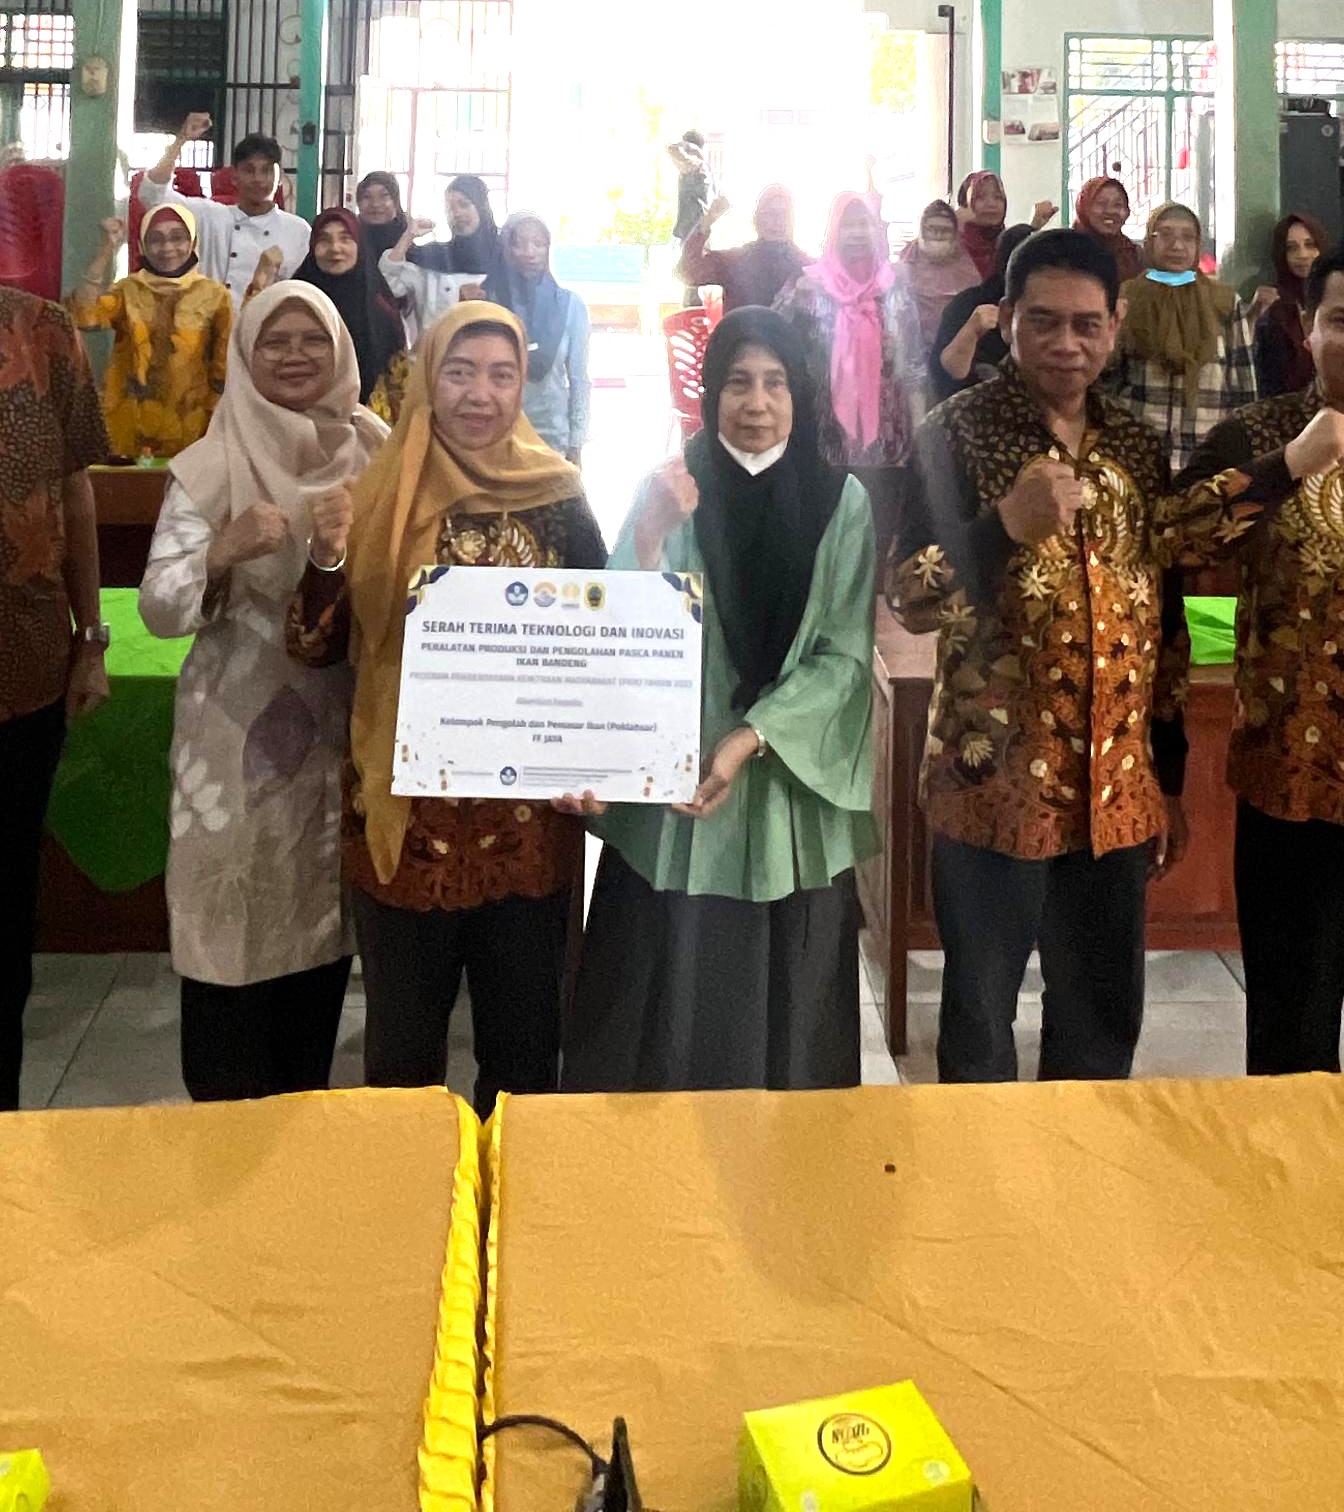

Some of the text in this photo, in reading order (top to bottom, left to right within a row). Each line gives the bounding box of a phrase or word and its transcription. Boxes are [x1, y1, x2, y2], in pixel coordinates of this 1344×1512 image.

[422, 620, 685, 640] SERAH TERIMA TEKNOLOGI DAN INOVASI
[421, 642, 684, 659] PERALATAN PRODUKSI DAN PENGOLAHAN PASCA PANEN
[516, 658, 587, 668] IKAN BANDENG
